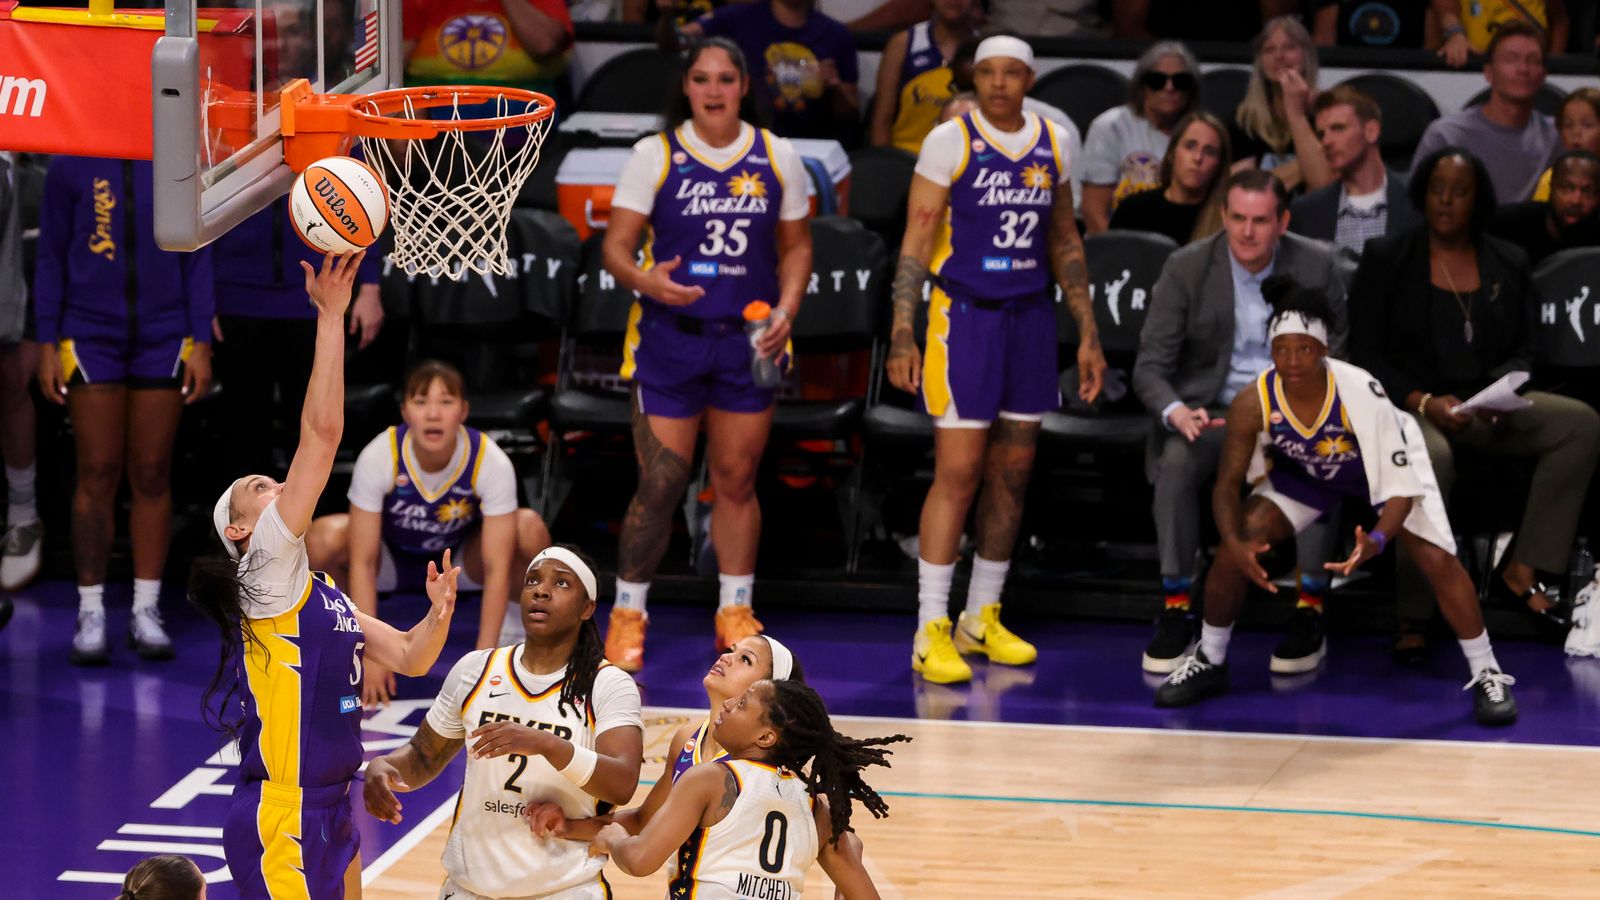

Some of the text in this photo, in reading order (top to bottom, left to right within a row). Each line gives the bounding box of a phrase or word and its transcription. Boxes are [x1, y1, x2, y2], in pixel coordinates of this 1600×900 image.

[314, 176, 359, 235] Wilson
[698, 218, 752, 257] 35
[992, 209, 1040, 249] 32
[349, 641, 365, 686] 5
[503, 753, 528, 794] 2
[759, 810, 788, 874] 0
